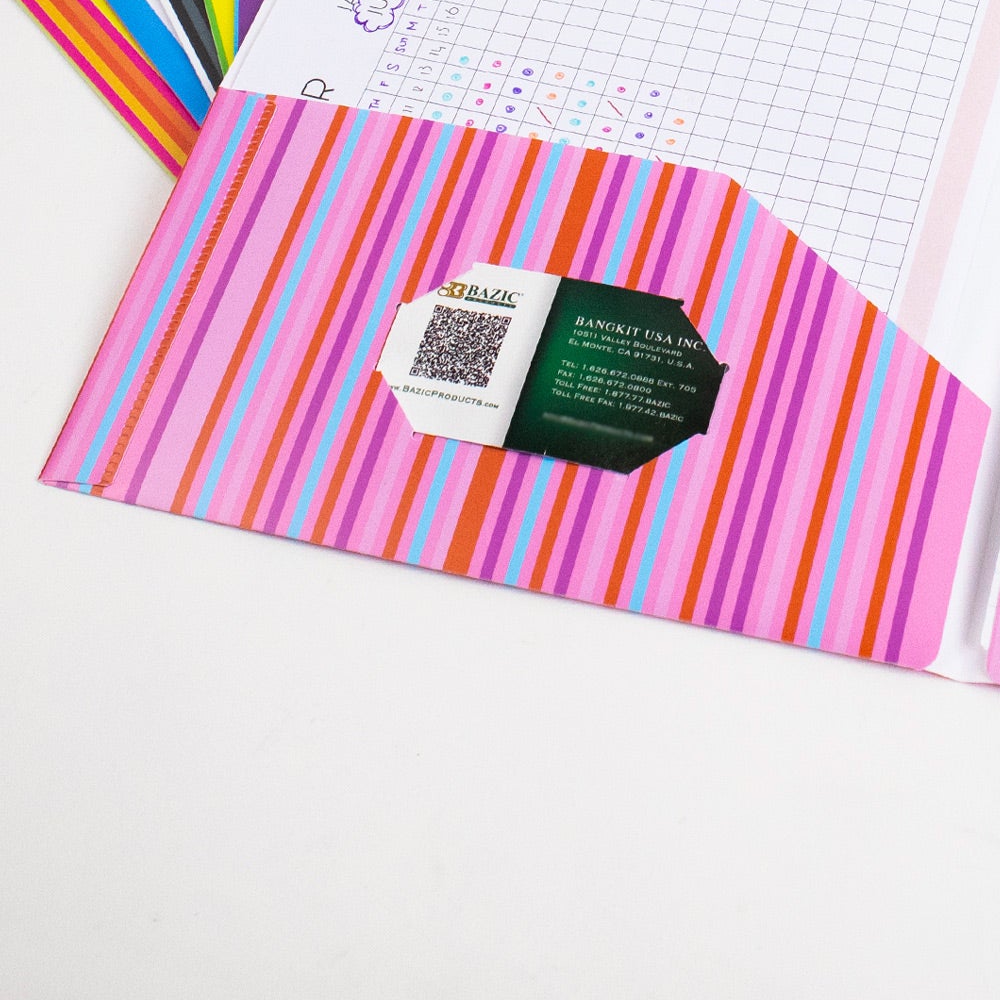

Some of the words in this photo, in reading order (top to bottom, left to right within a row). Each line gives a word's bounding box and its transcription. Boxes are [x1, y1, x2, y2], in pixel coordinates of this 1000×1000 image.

[446, 7, 459, 19] 16
[406, 21, 418, 30] M
[467, 284, 521, 303] BAZIC
[575, 316, 642, 337] BANGKIT
[645, 329, 673, 345] USA
[677, 337, 706, 352] INC.
[617, 348, 631, 356] CA
